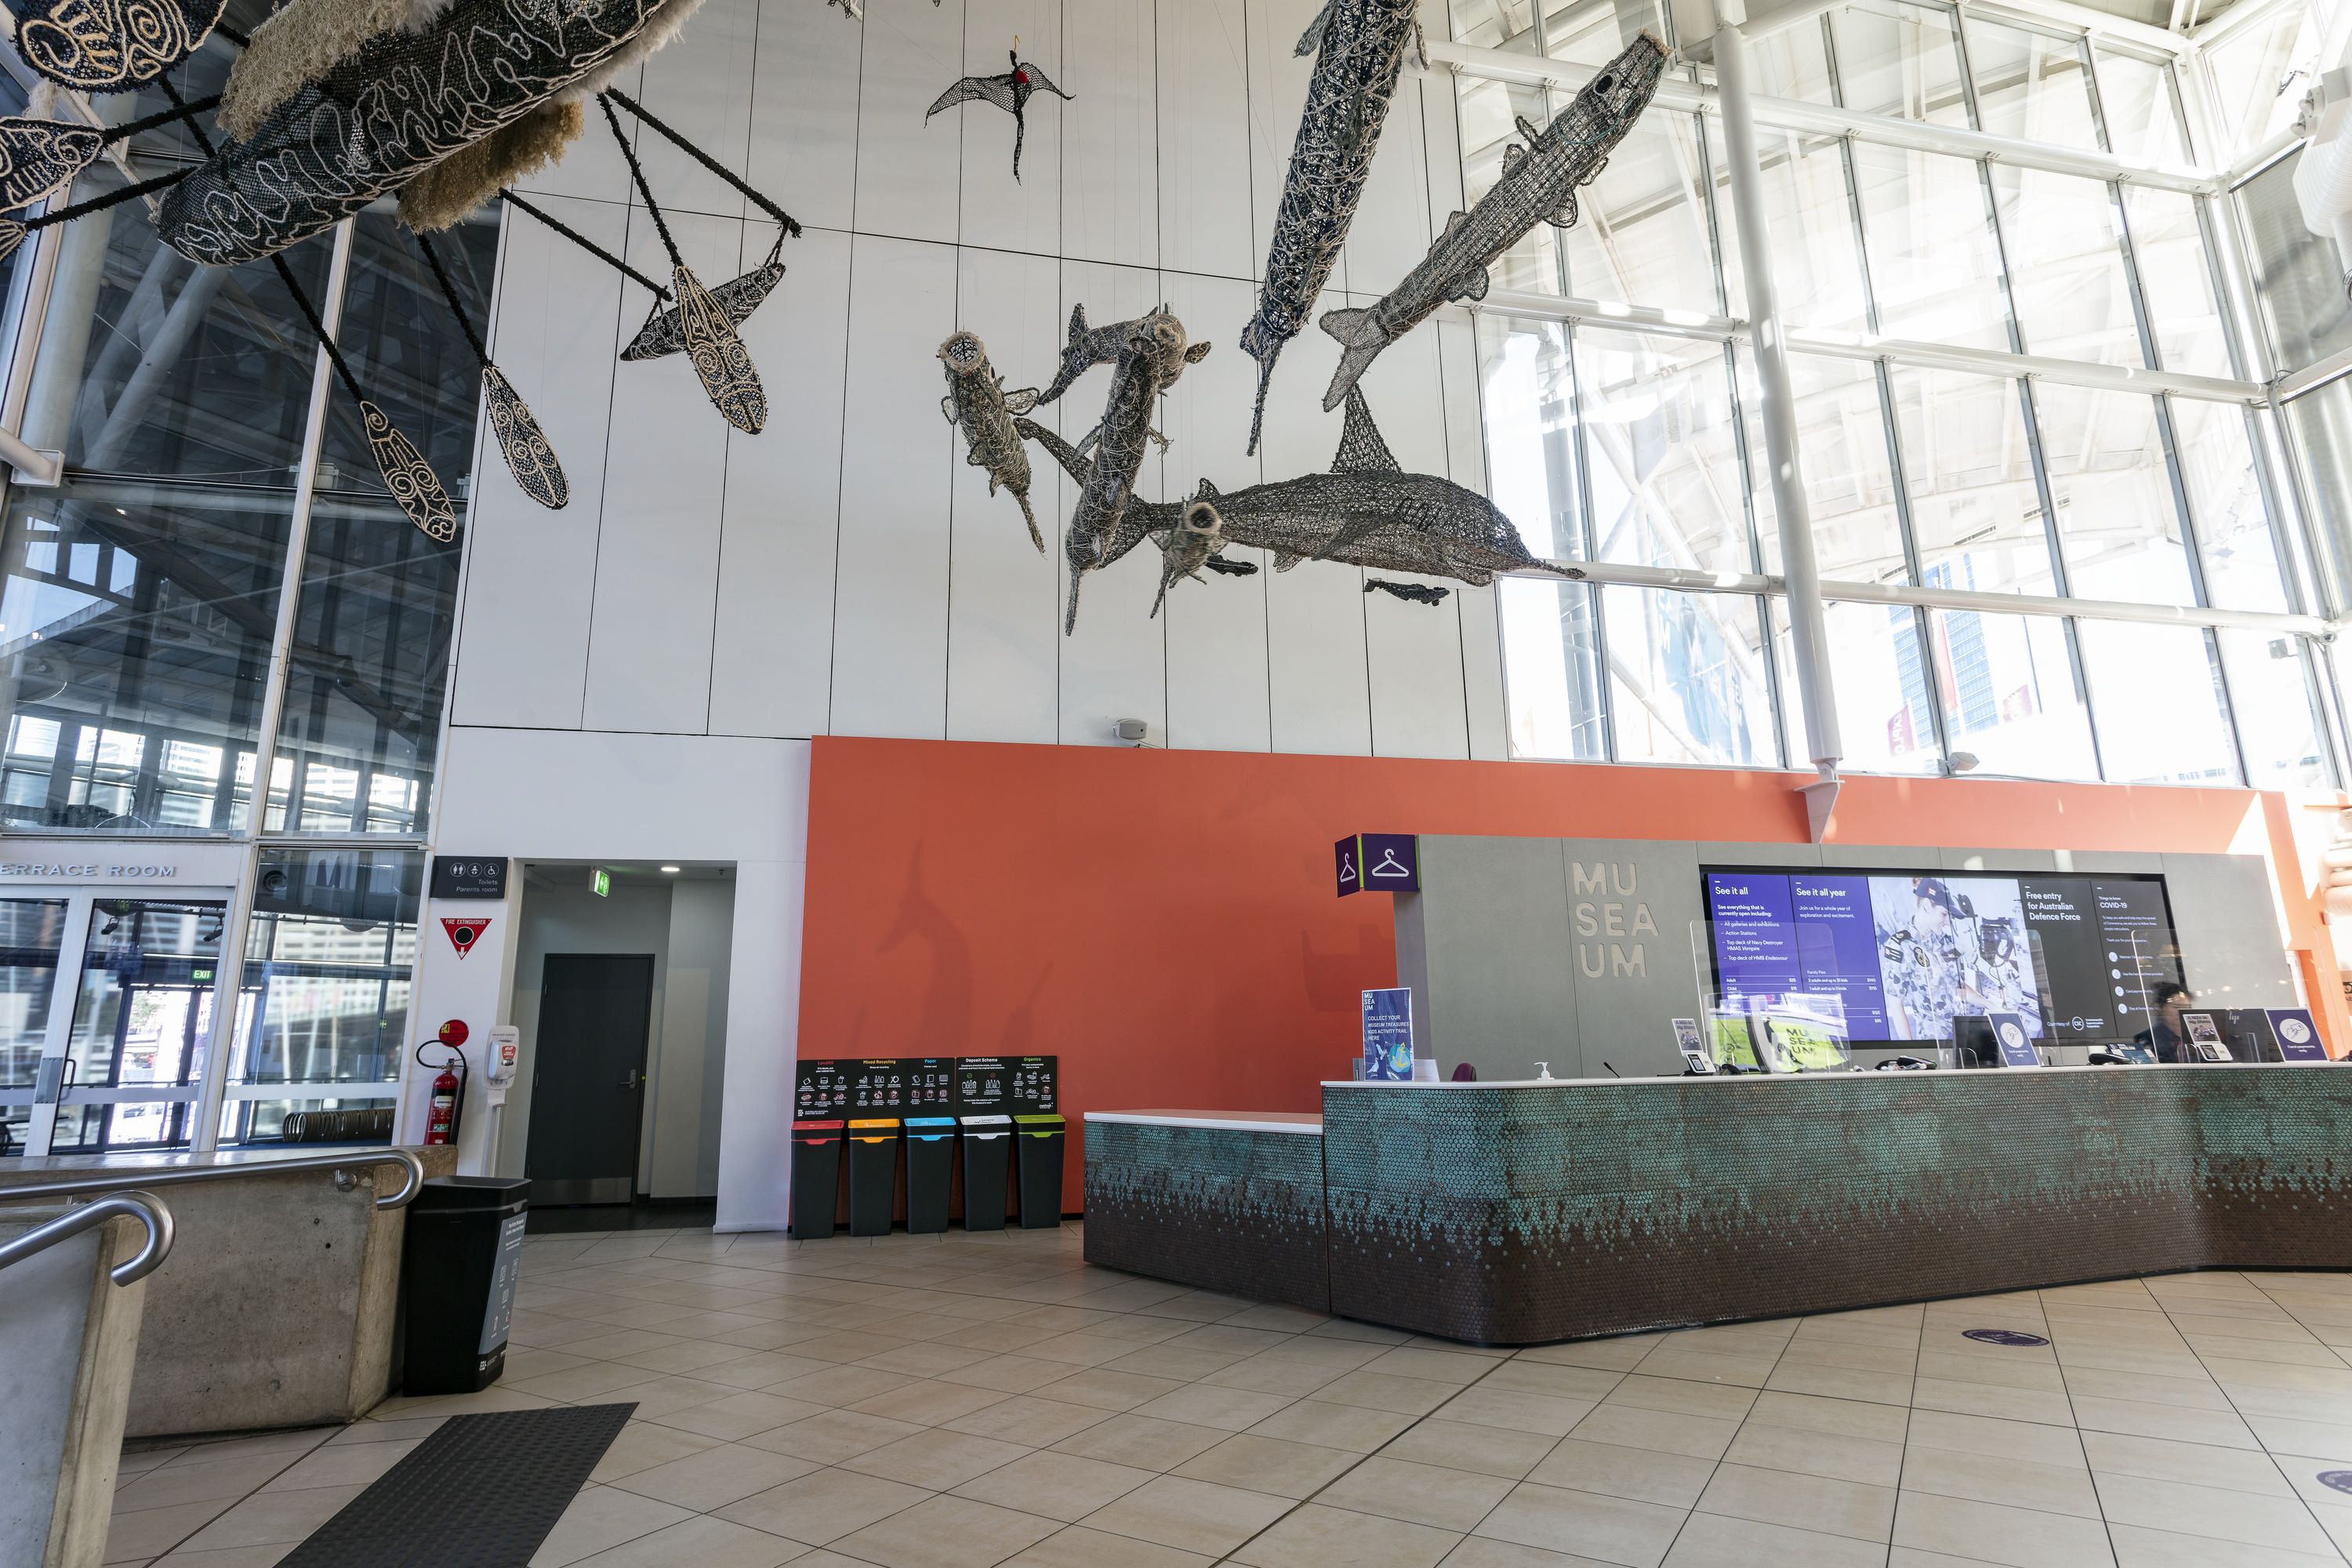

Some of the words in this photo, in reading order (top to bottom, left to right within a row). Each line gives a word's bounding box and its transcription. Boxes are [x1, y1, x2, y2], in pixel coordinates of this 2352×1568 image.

[108, 865, 177, 877] ROOM
[1572, 862, 1637, 895] MU
[1739, 887, 1748, 895] all
[2043, 893, 2061, 902] entry
[1575, 902, 1660, 936] SEA
[1580, 943, 1647, 978] UM
[194, 970, 212, 979] EXIT
